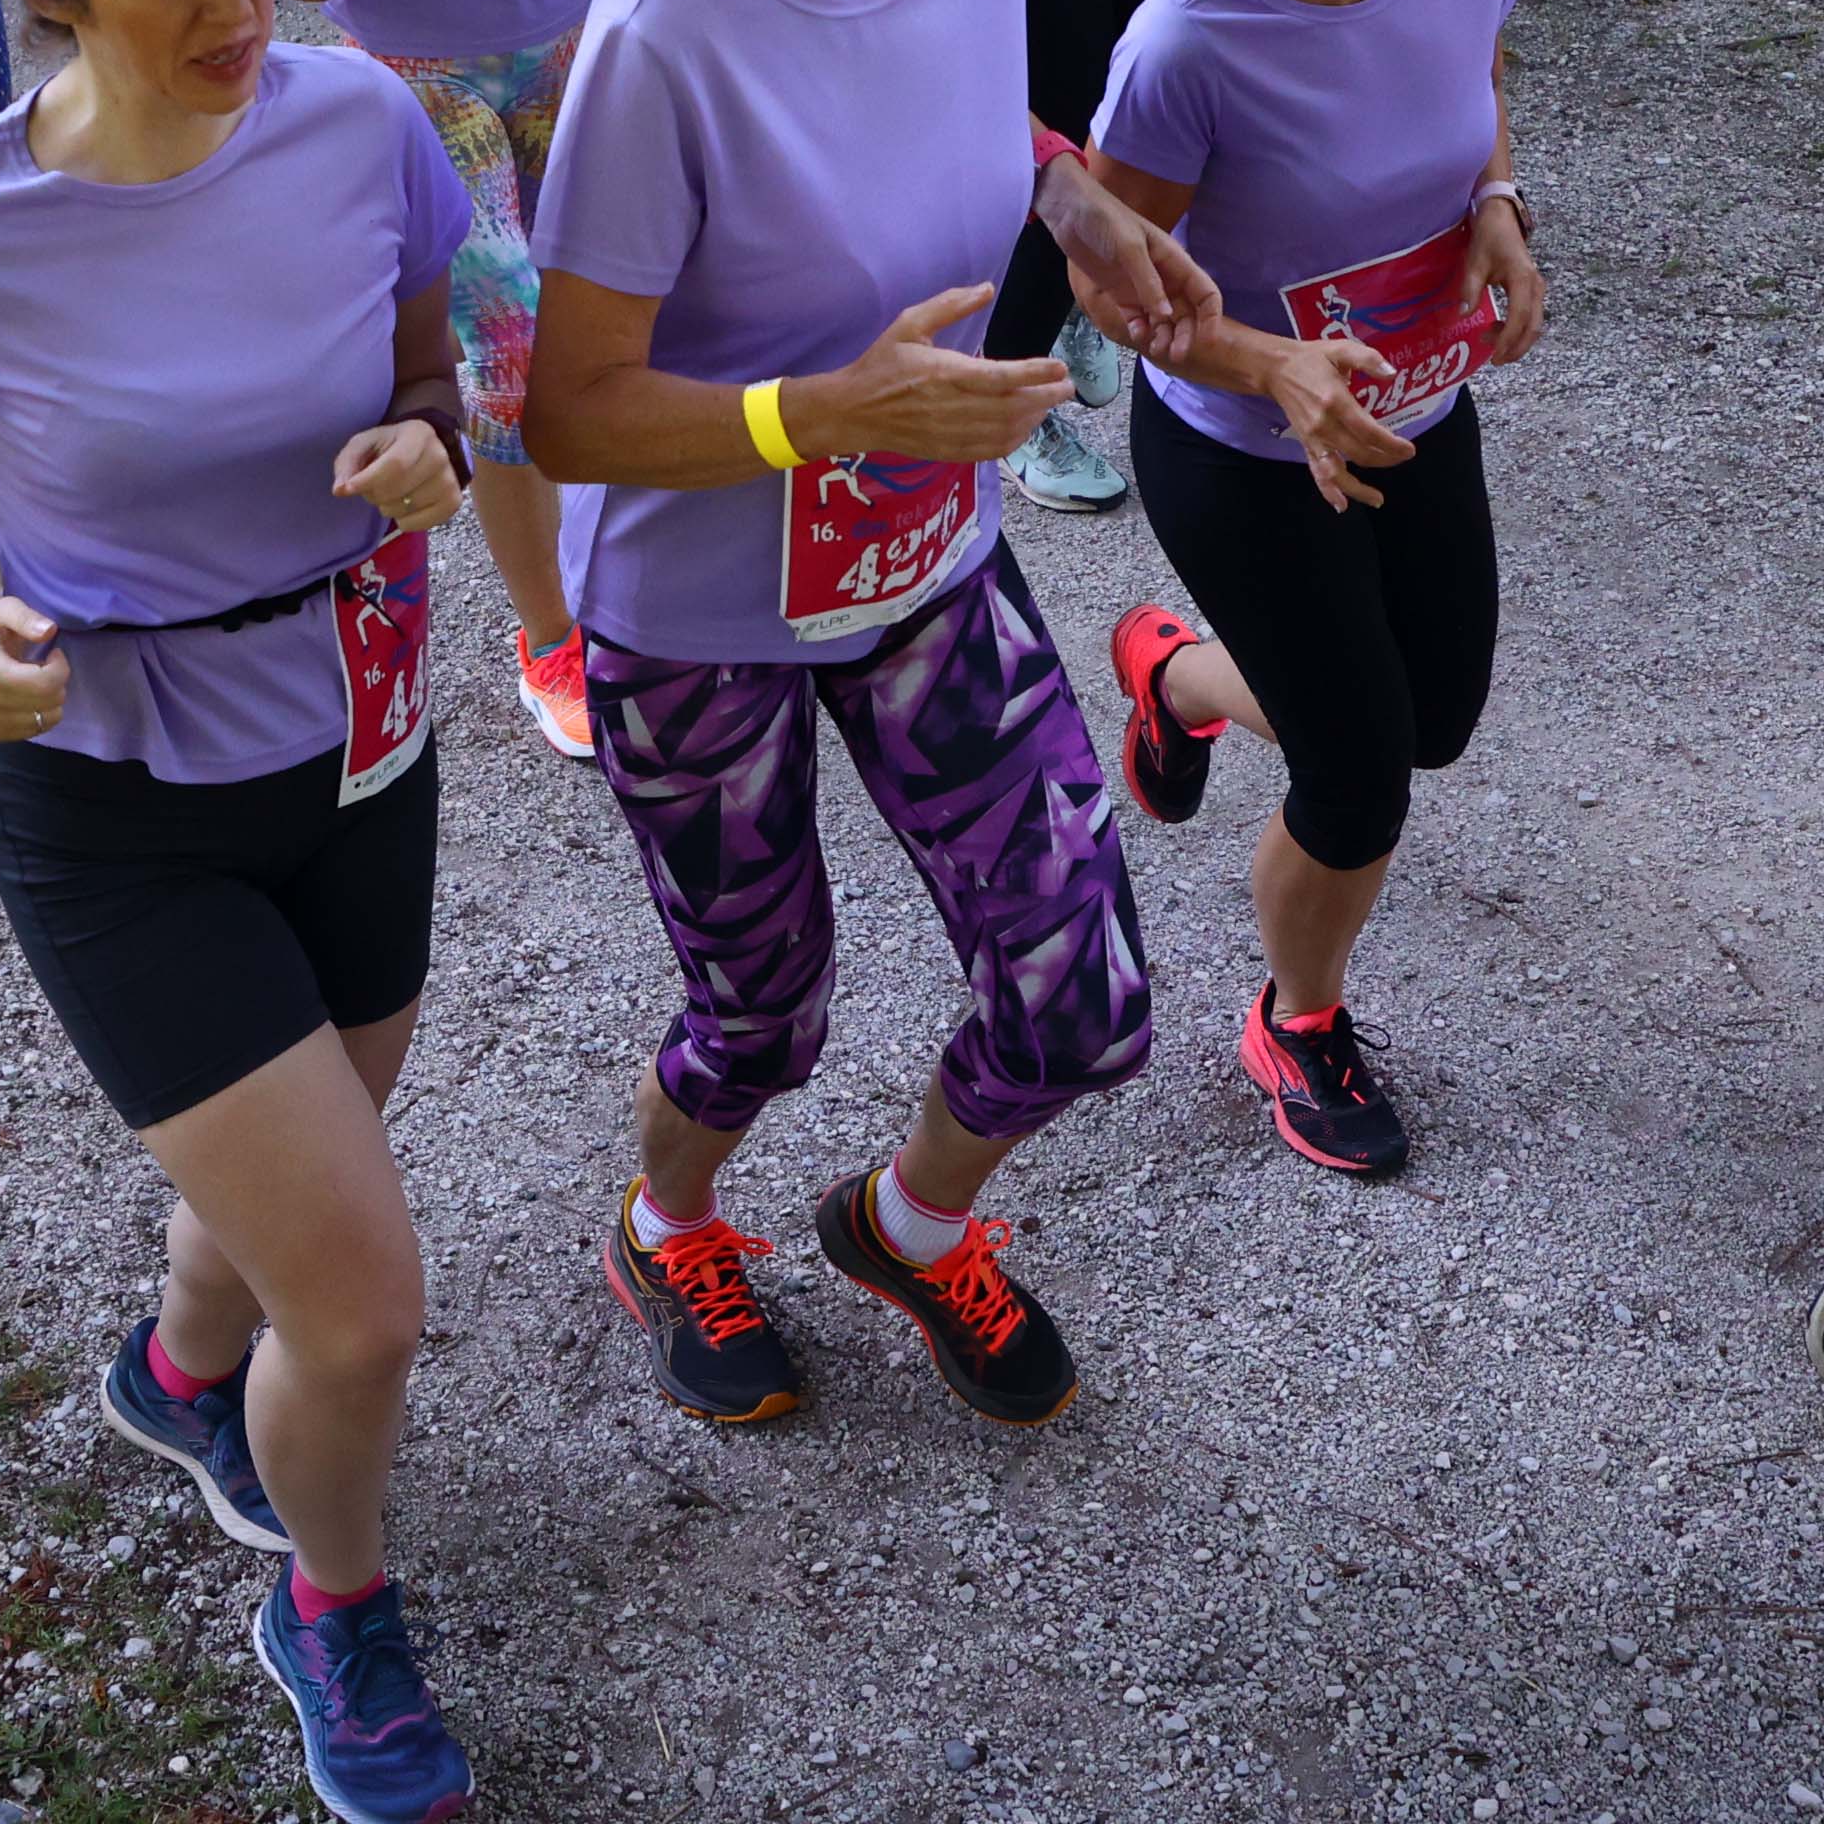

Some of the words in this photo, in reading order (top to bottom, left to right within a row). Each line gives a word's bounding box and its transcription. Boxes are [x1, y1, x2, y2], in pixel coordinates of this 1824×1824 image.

[810, 521, 843, 543] 16.
[837, 481, 960, 600] 4276
[819, 613, 851, 629] LPP
[363, 662, 386, 690] 16.
